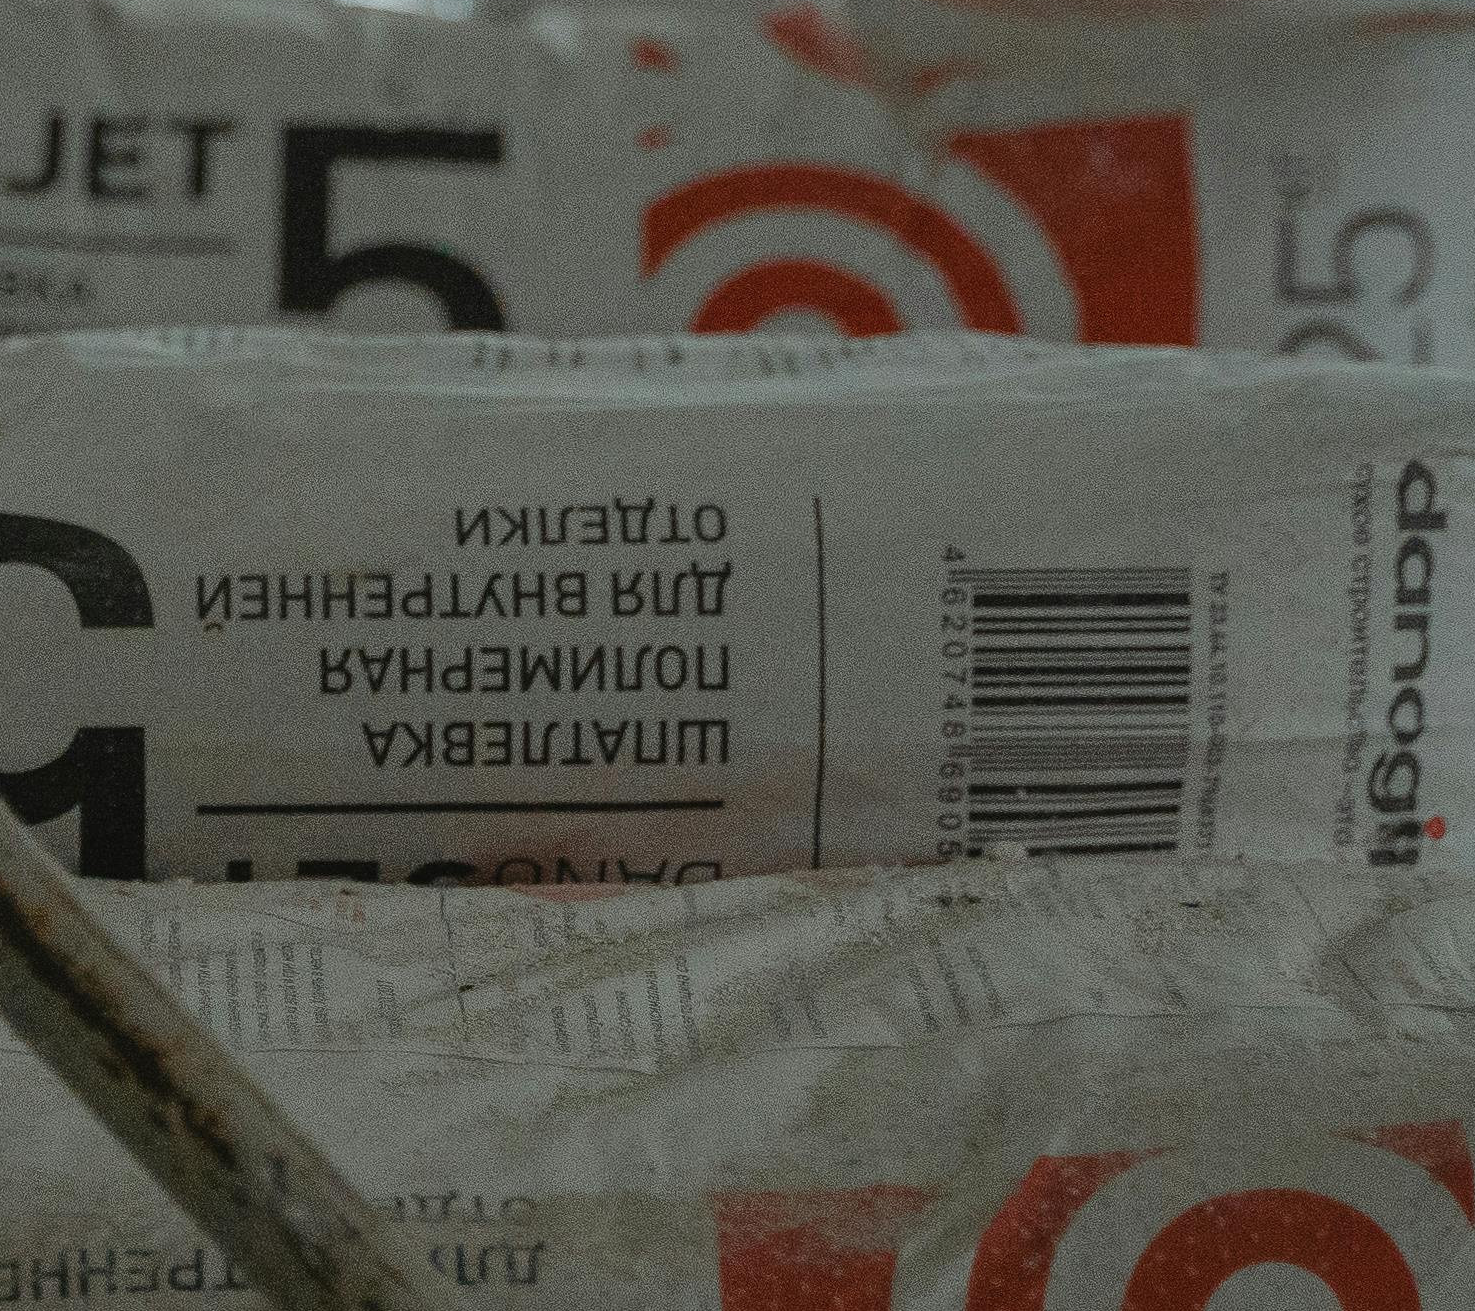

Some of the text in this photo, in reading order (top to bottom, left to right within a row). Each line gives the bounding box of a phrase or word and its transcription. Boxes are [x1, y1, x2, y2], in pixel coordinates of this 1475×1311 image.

[278, 119, 507, 331] 5
[454, 503, 727, 546] ОТДЕЛКИ
[195, 565, 731, 632] ДЛЯ ВНУТРЕННЕЙ
[319, 643, 730, 695] ПОЛИМЕРНАЯ
[363, 720, 730, 767] ШПАТЛЕВКА
